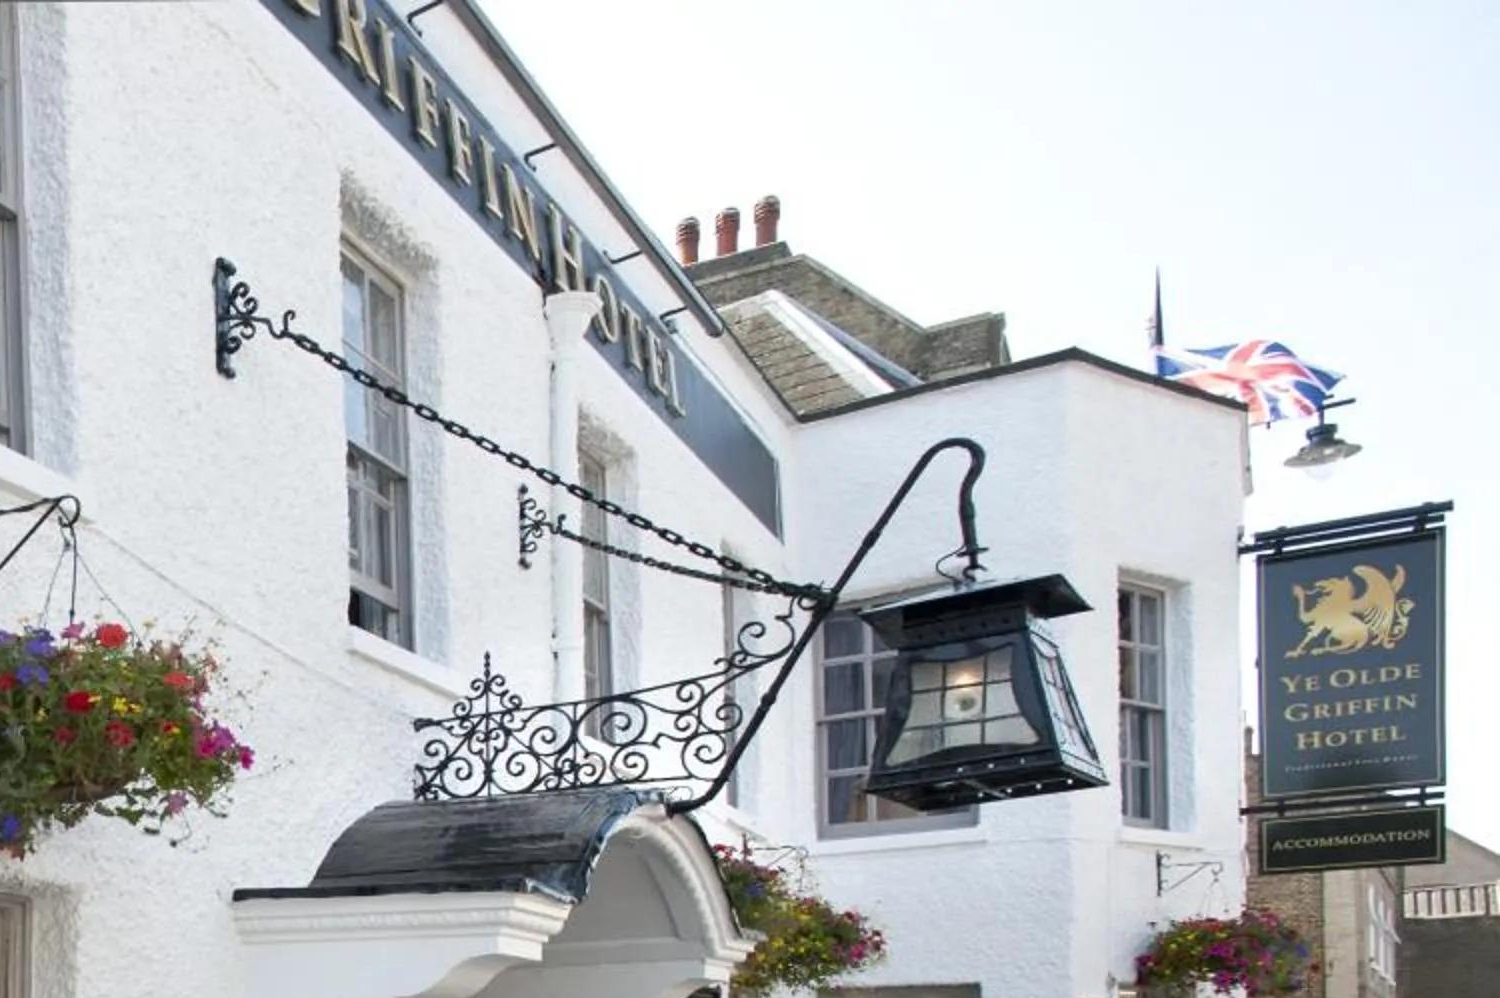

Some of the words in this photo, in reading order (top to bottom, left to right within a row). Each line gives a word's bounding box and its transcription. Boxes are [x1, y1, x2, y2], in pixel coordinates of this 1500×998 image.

[288, 0, 543, 262] RIFFIN
[546, 202, 686, 417] HOTEL
[1279, 674, 1320, 693] YE
[1329, 663, 1422, 688] OLDE
[1283, 693, 1417, 722] GRIFFIN
[1296, 725, 1407, 750] HOTEL
[1272, 828, 1431, 851] ACCOMMODATION
